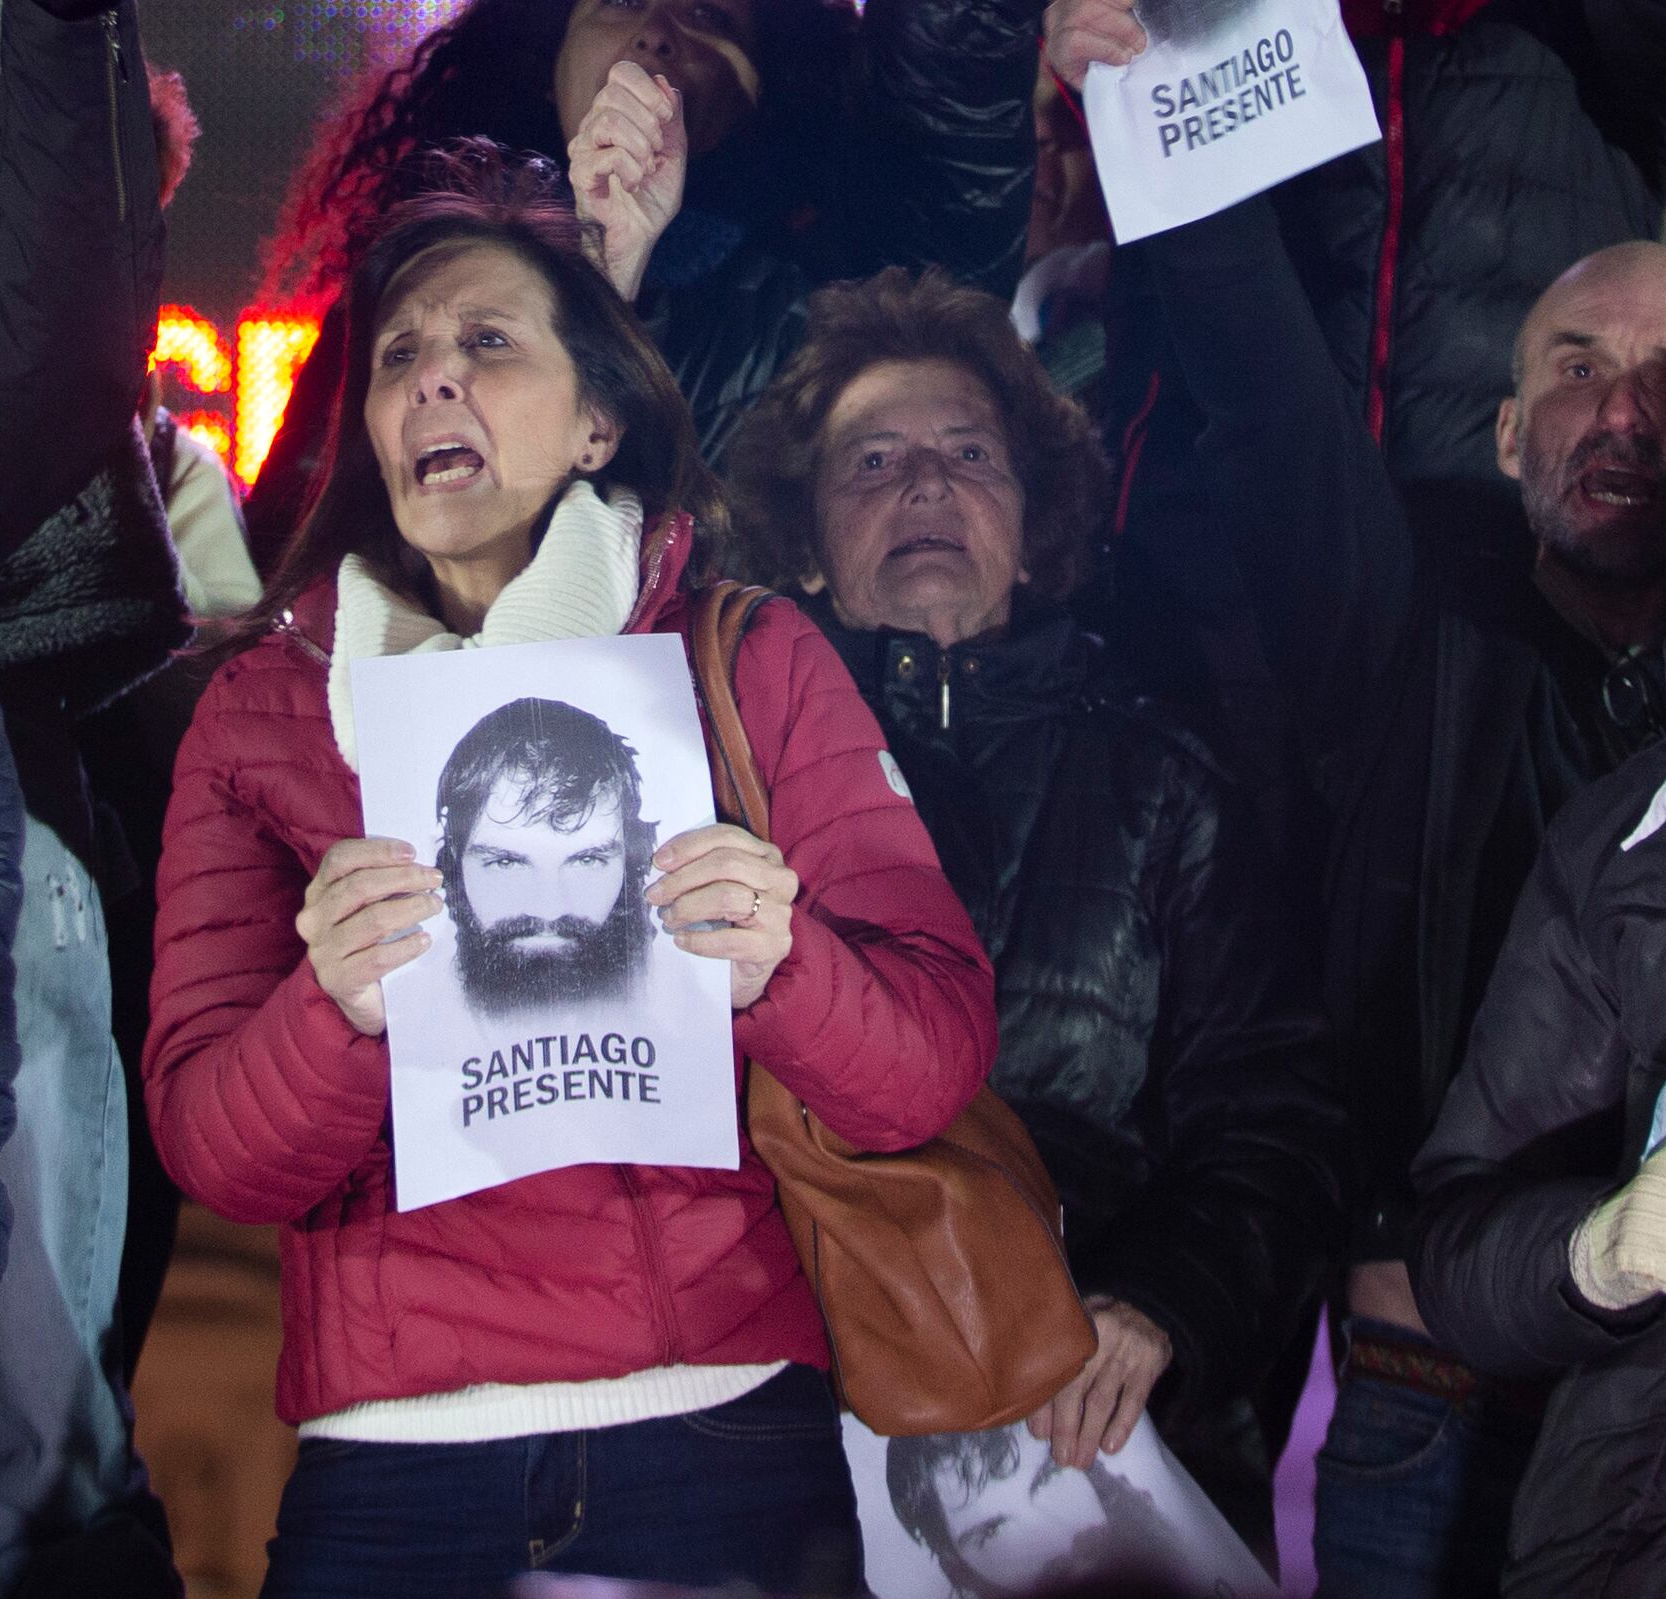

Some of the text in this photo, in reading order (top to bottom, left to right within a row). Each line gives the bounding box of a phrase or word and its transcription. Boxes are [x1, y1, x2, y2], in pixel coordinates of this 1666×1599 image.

[1151, 29, 1294, 118] SANTIAGO
[1158, 64, 1306, 158] PRESENTE
[461, 1032, 656, 1090] SANTIAGO
[462, 1069, 661, 1128] PRESENTE
